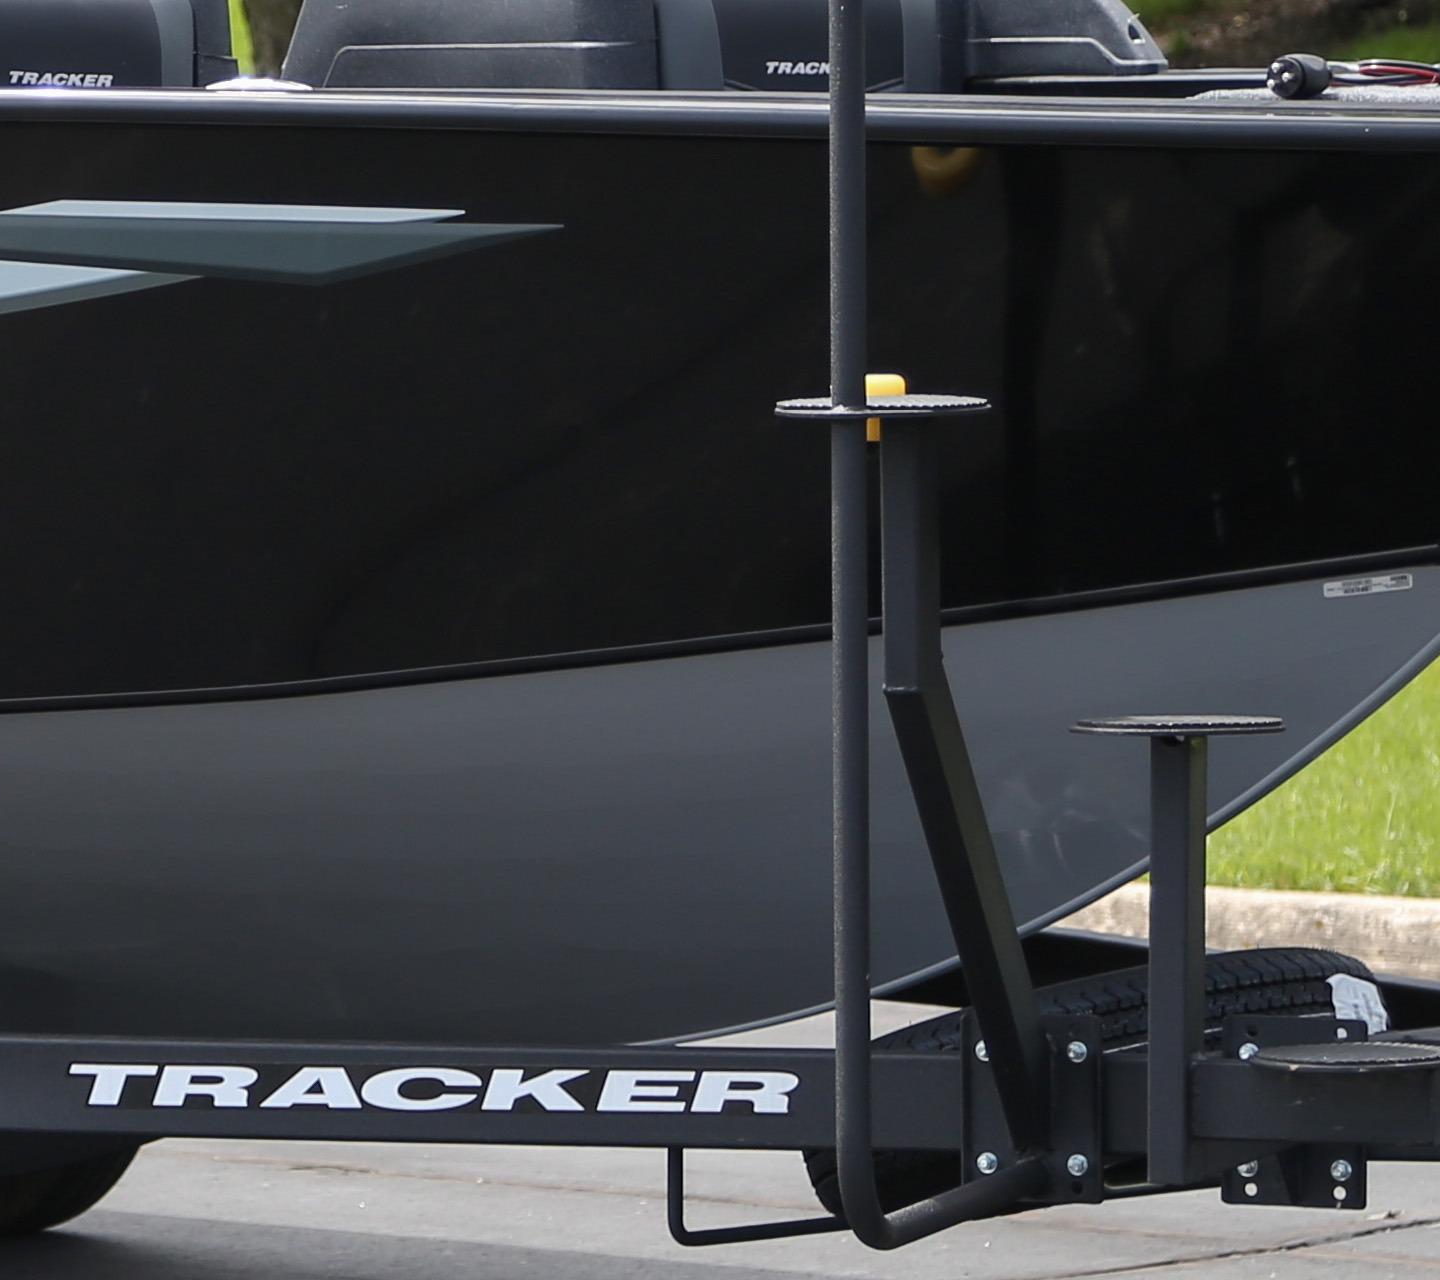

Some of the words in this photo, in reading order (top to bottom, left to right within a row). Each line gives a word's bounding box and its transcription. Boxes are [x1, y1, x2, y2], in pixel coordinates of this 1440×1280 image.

[765, 61, 830, 75] TRACK
[9, 70, 114, 88] TRACKER
[69, 1063, 800, 1115] TRACKER
